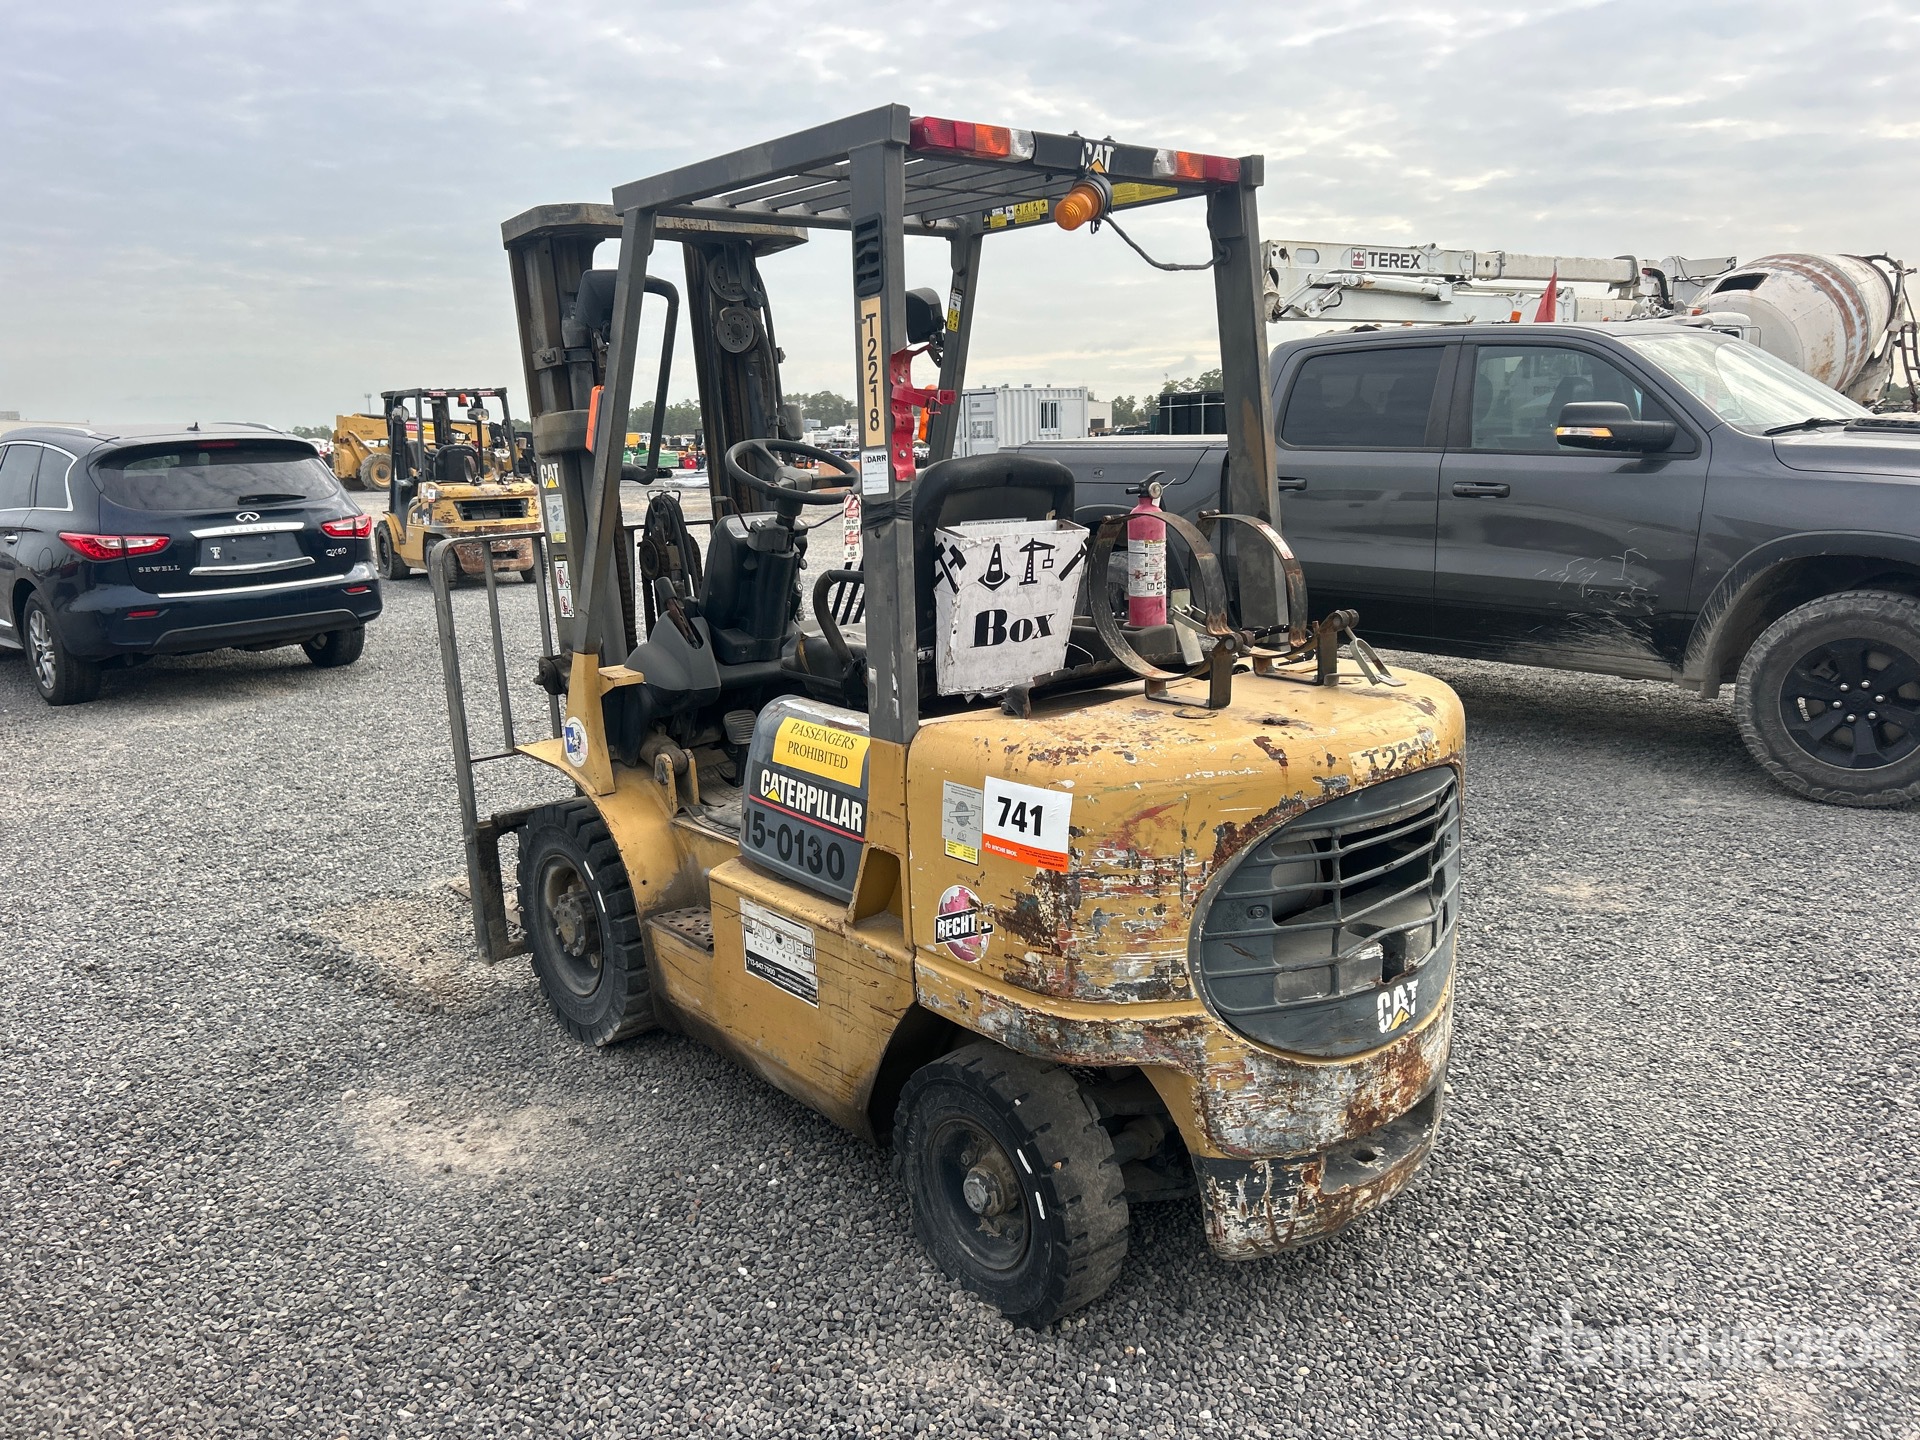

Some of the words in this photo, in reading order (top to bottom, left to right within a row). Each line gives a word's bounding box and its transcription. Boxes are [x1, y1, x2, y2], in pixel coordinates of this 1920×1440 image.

[1080, 142, 1115, 173] CAT
[1368, 252, 1421, 269] TEREX
[865, 313, 880, 431] T2218
[867, 454, 887, 463] DARR
[540, 463, 559, 489] CAT
[325, 547, 347, 557] QX60
[138, 564, 181, 573] SEWELL
[970, 609, 1055, 648] Box
[790, 722, 858, 750] PASSENGERS
[787, 741, 848, 769] PROHIBITED
[760, 769, 863, 833] CATERPILLAR
[997, 796, 1043, 836] 741
[743, 807, 845, 881] 15-0130
[754, 941, 804, 967] EQUIPMENT
[1377, 979, 1419, 1033] CAT
